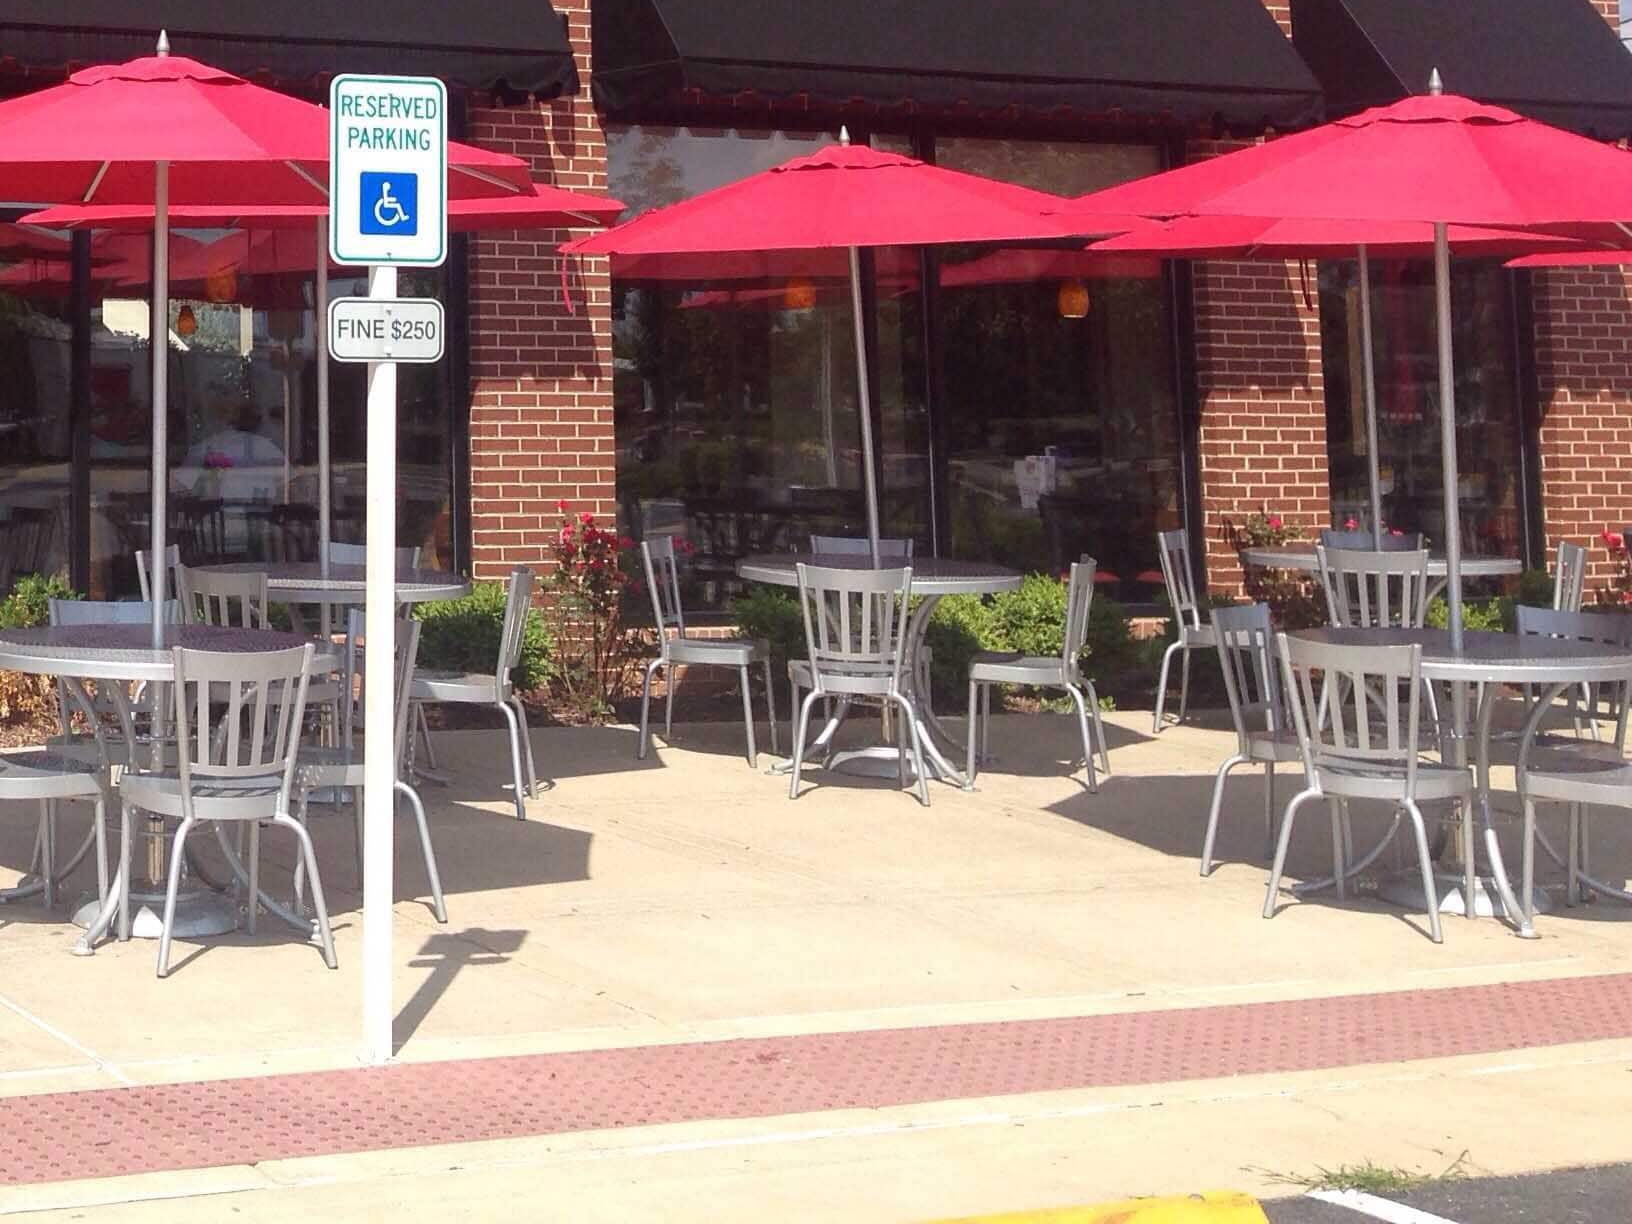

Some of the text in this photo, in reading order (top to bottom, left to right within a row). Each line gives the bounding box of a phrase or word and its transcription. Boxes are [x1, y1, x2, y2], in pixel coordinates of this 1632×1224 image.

[341, 94, 437, 120] RESERVED
[348, 126, 431, 151] PARKING
[337, 319, 436, 341] FINE $250
